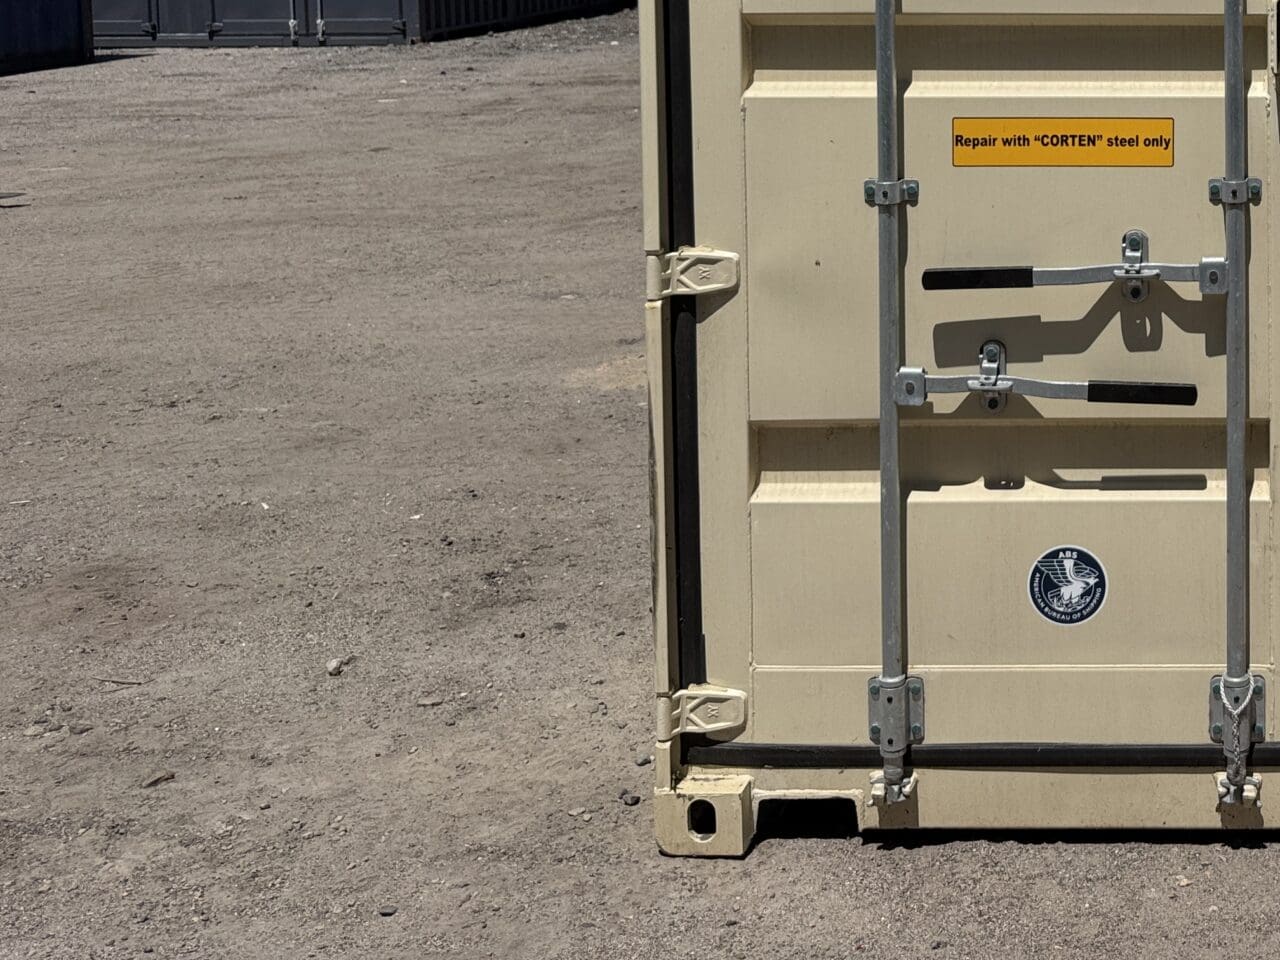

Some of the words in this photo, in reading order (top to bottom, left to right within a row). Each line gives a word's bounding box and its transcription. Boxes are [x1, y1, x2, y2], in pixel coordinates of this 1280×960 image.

[955, 134, 998, 150] Repair
[1001, 134, 1030, 147] with
[1106, 134, 1139, 147] steel
[1143, 135, 1171, 150] only
[1058, 550, 1078, 559] ABS
[1044, 607, 1070, 620] BUREAU
[1072, 612, 1081, 620] OF
